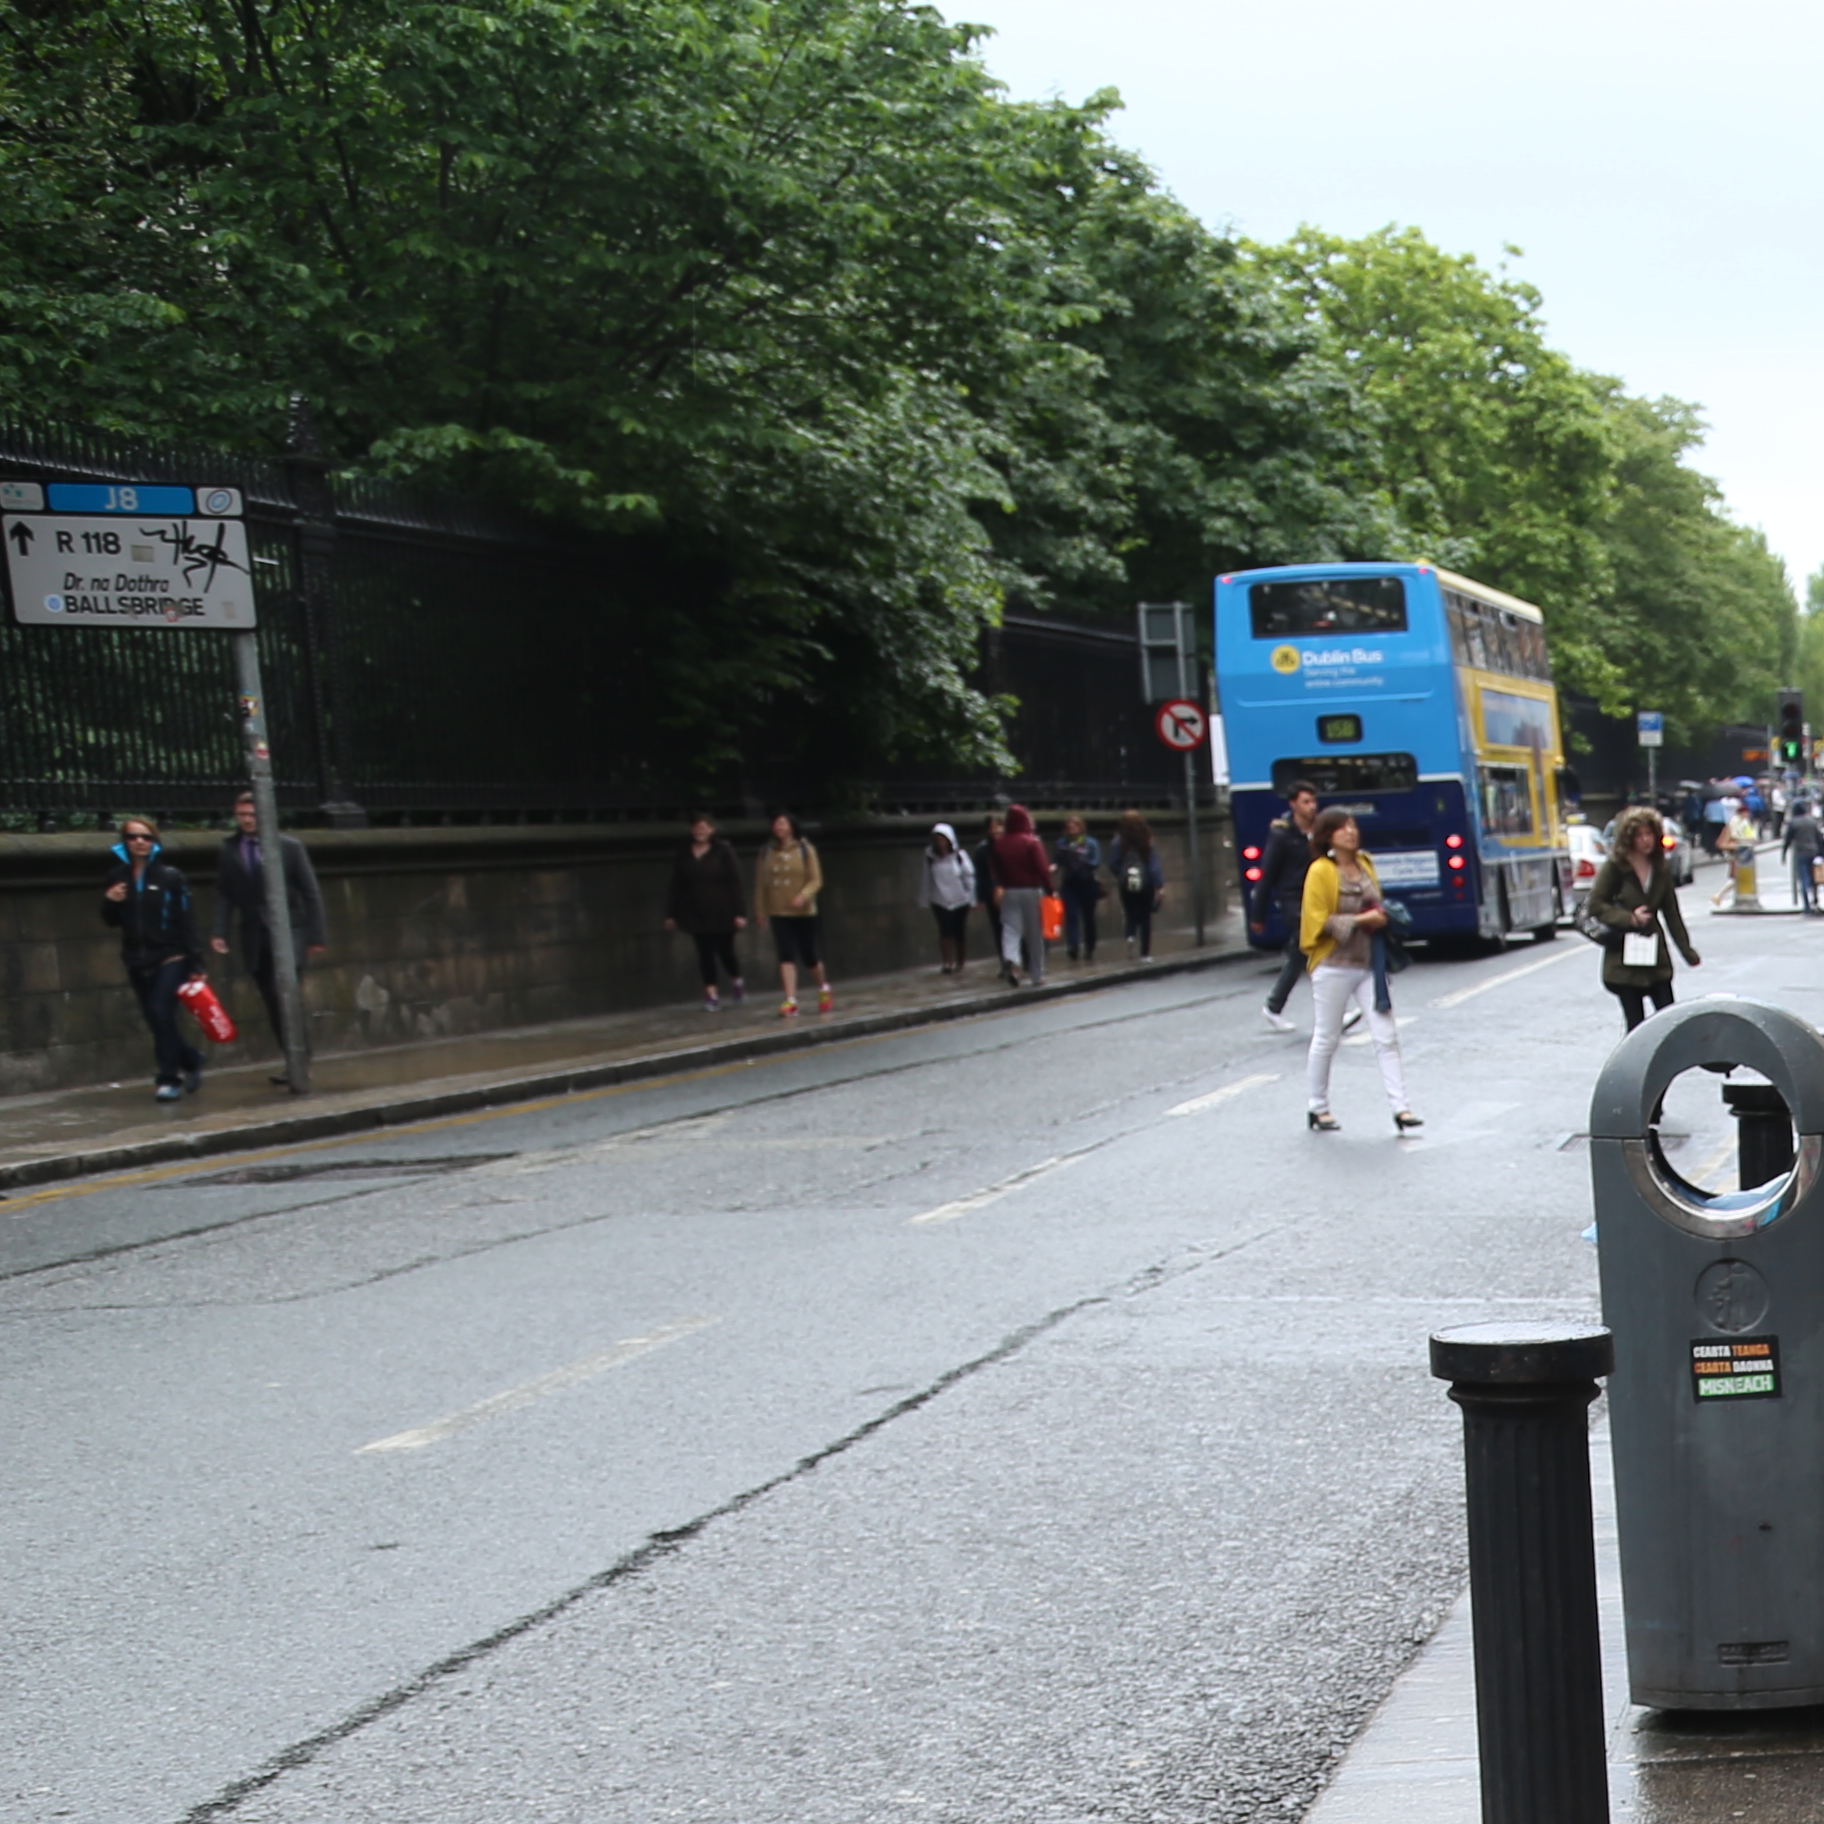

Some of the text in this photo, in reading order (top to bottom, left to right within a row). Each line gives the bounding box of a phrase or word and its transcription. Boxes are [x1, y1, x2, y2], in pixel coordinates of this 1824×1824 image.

[105, 487, 139, 510] J8
[56, 531, 121, 554] R 118
[64, 572, 85, 590] Dr.
[91, 578, 110, 592] na
[65, 595, 206, 617] BALLSBRIDGE
[1302, 648, 1383, 667] Dublin Bus
[1699, 1375, 1773, 1396] MISNEACH
